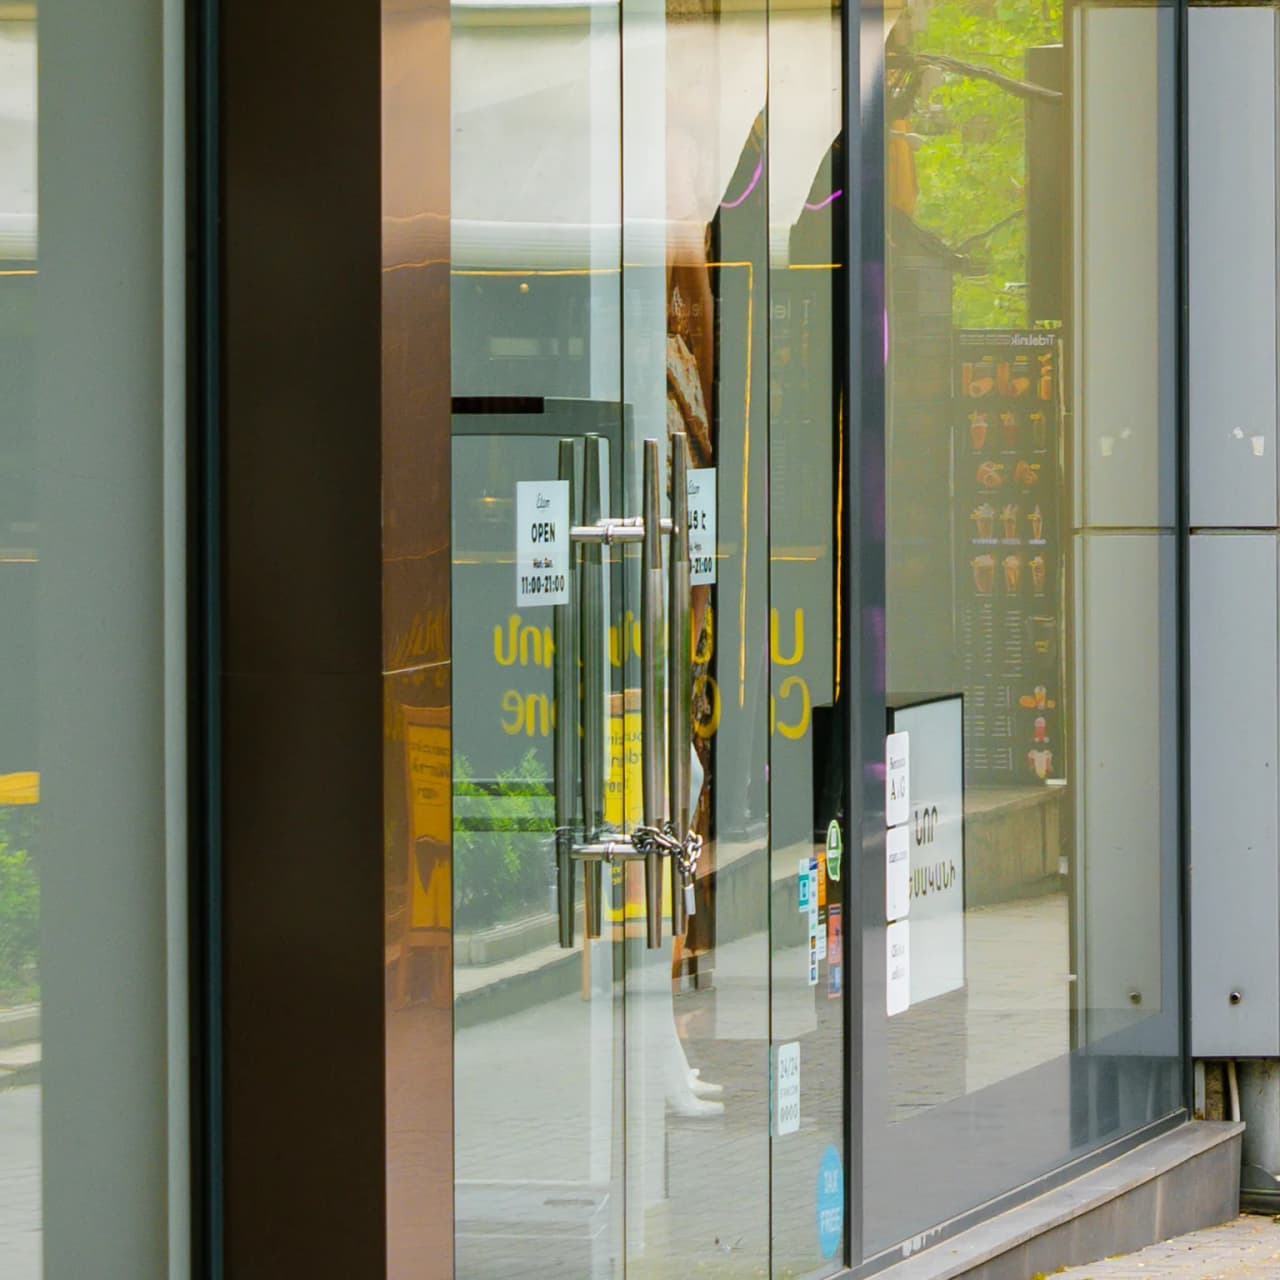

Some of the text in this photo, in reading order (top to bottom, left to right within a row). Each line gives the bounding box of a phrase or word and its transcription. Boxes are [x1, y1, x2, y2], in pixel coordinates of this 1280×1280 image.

[531, 521, 556, 544] OPEN
[521, 575, 565, 595] 11:00-21:00
[914, 804, 938, 846] ՆՈՐ
[820, 1207, 842, 1232] FREE
